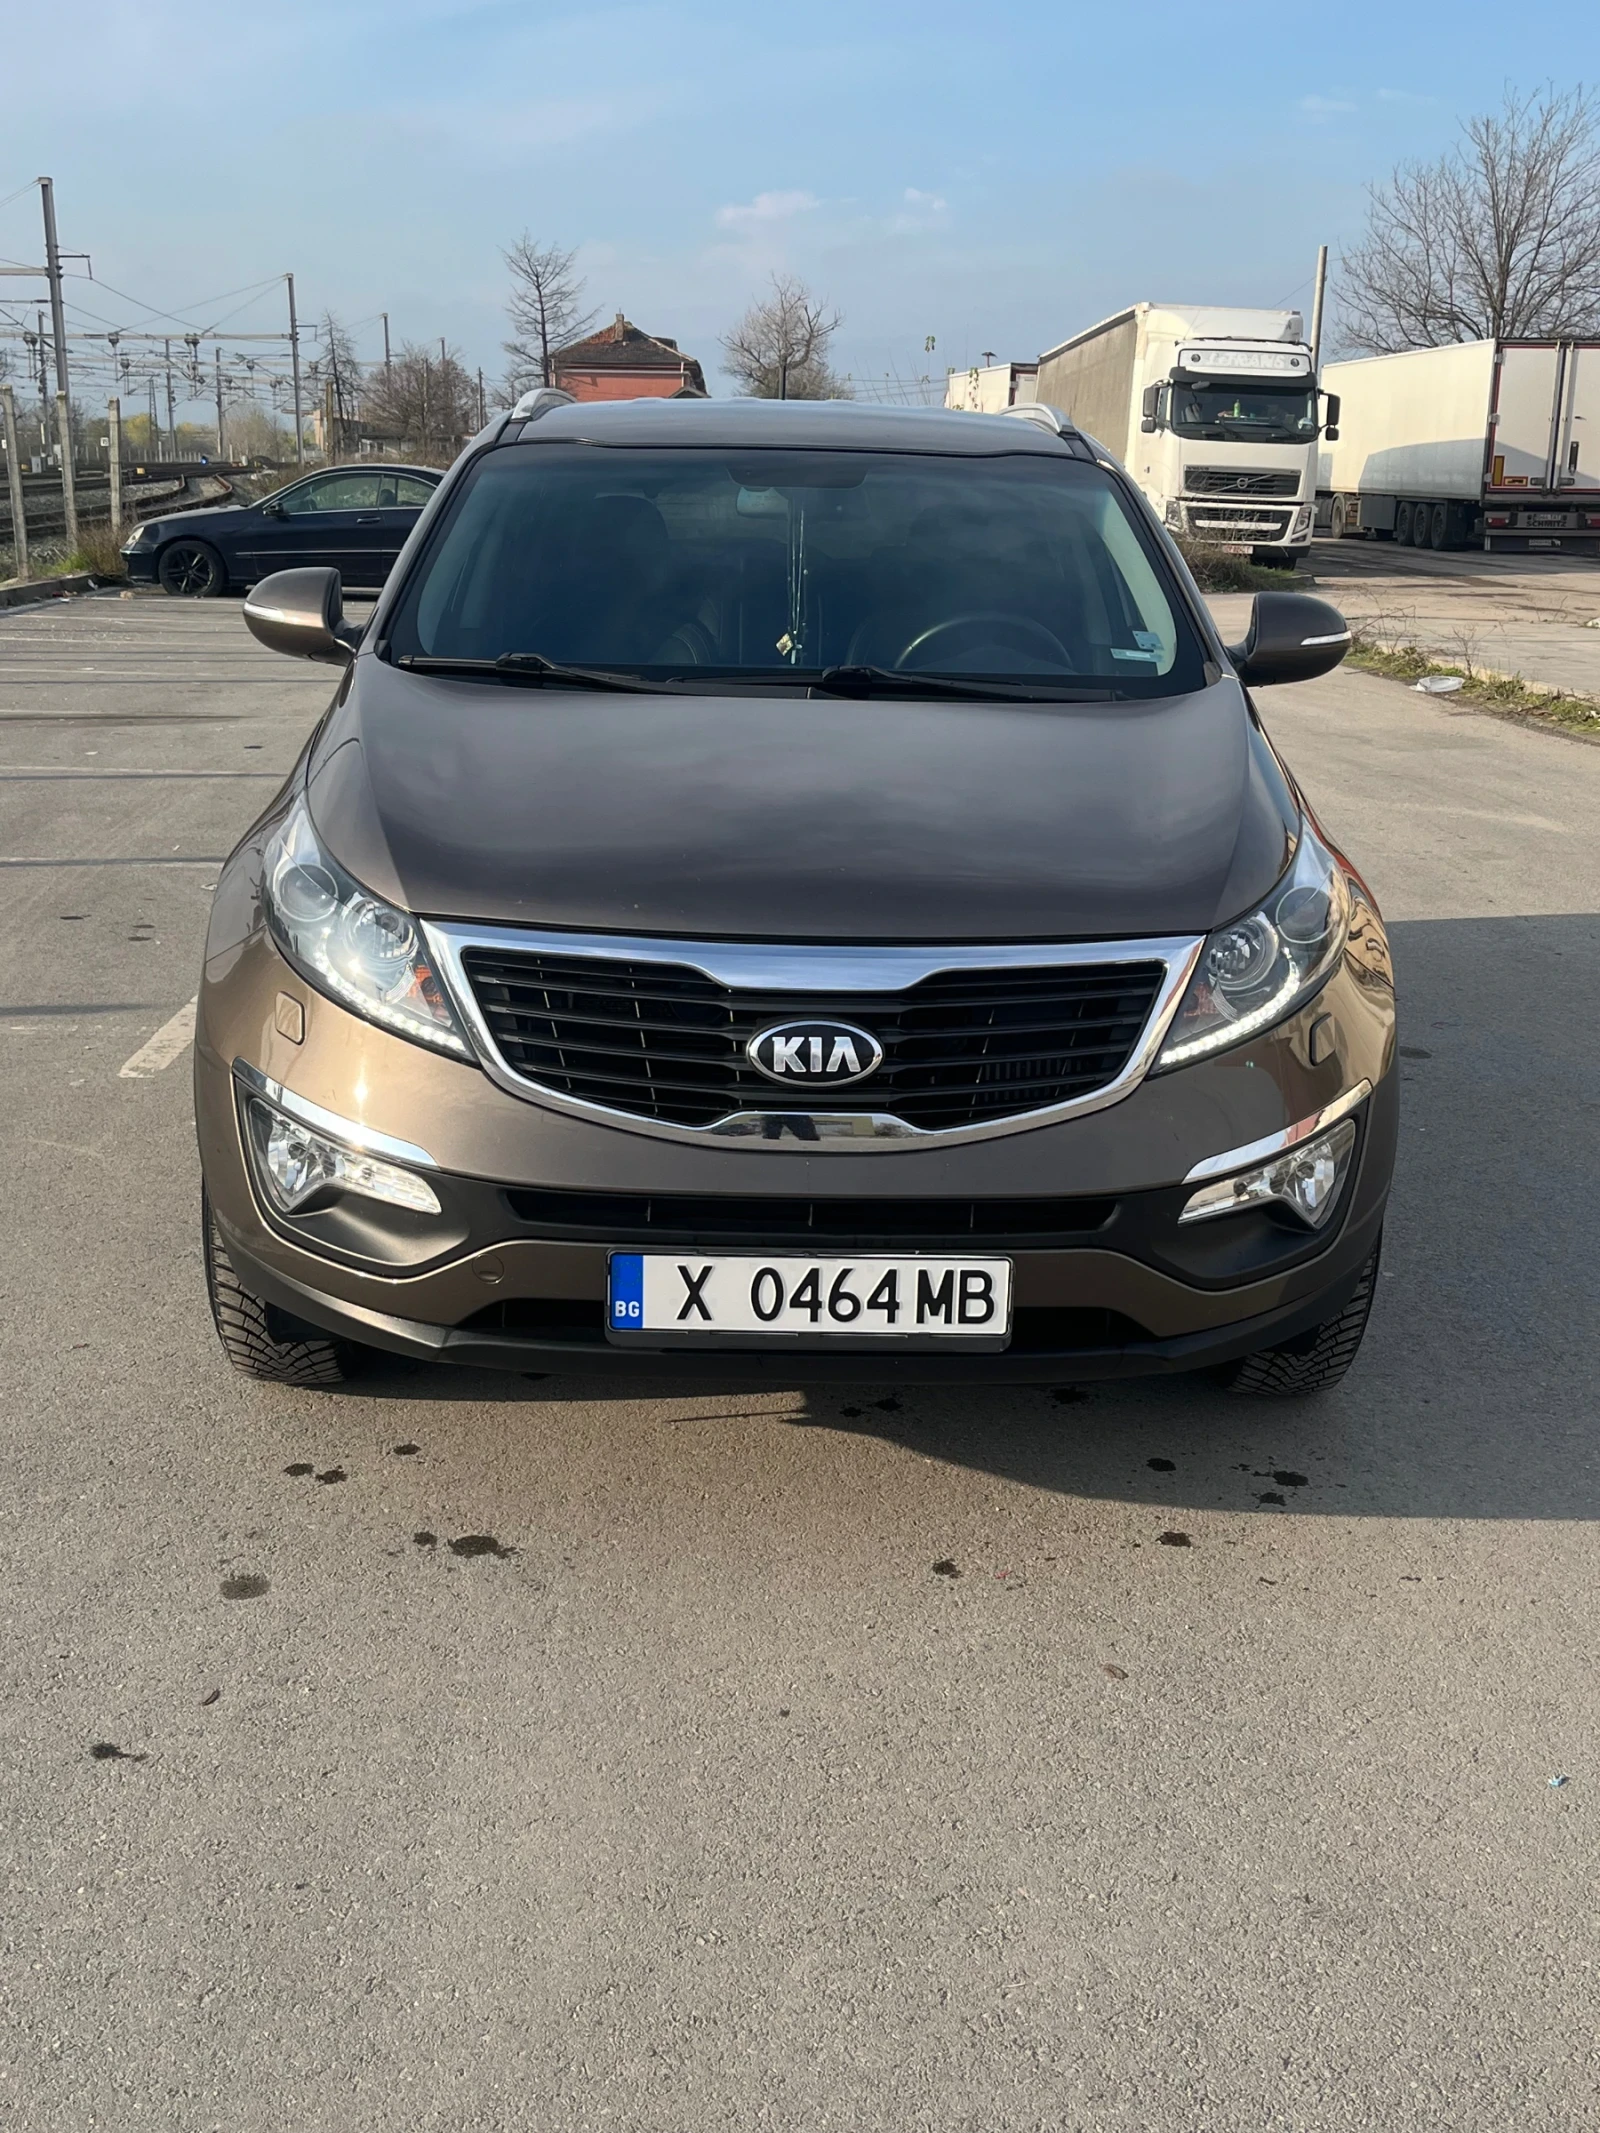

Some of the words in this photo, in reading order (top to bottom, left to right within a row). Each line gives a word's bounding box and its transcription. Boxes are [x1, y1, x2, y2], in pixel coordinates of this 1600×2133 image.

[772, 1036, 861, 1073] KIA
[614, 1300, 640, 1317] BG
[676, 1265, 713, 1321] X
[750, 1267, 900, 1324] 0464
[915, 1269, 995, 1325] MB
